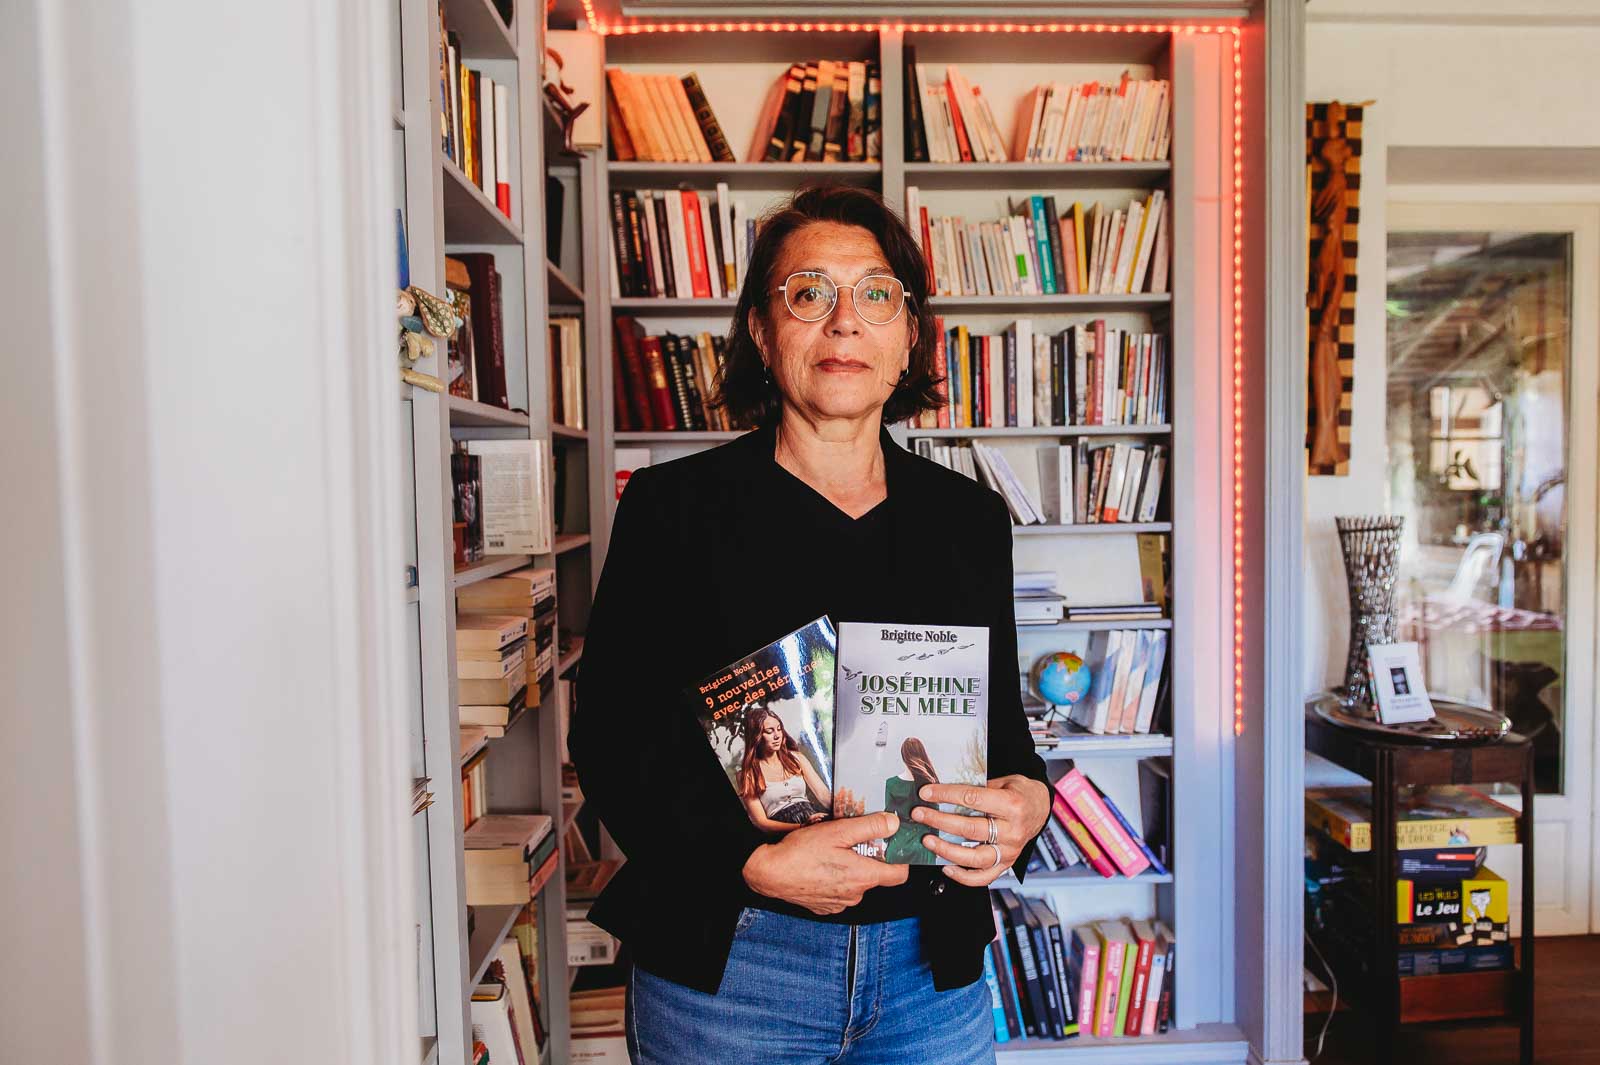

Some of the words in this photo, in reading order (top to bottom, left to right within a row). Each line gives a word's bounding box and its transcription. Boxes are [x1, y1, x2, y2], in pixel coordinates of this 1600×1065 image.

[880, 629, 923, 644] Brigitte
[924, 630, 958, 643] Noble
[699, 673, 733, 694] Brigitte
[733, 661, 757, 677] Noble
[706, 697, 715, 708] 9
[718, 665, 780, 702] nouvelles
[856, 671, 981, 696] JOSÉPHINE
[713, 701, 742, 720] avec
[744, 687, 766, 704] des
[861, 696, 911, 715] S'EN
[918, 694, 977, 717] MÊLE
[1416, 903, 1432, 916] Le
[1435, 902, 1460, 915] Jeu
